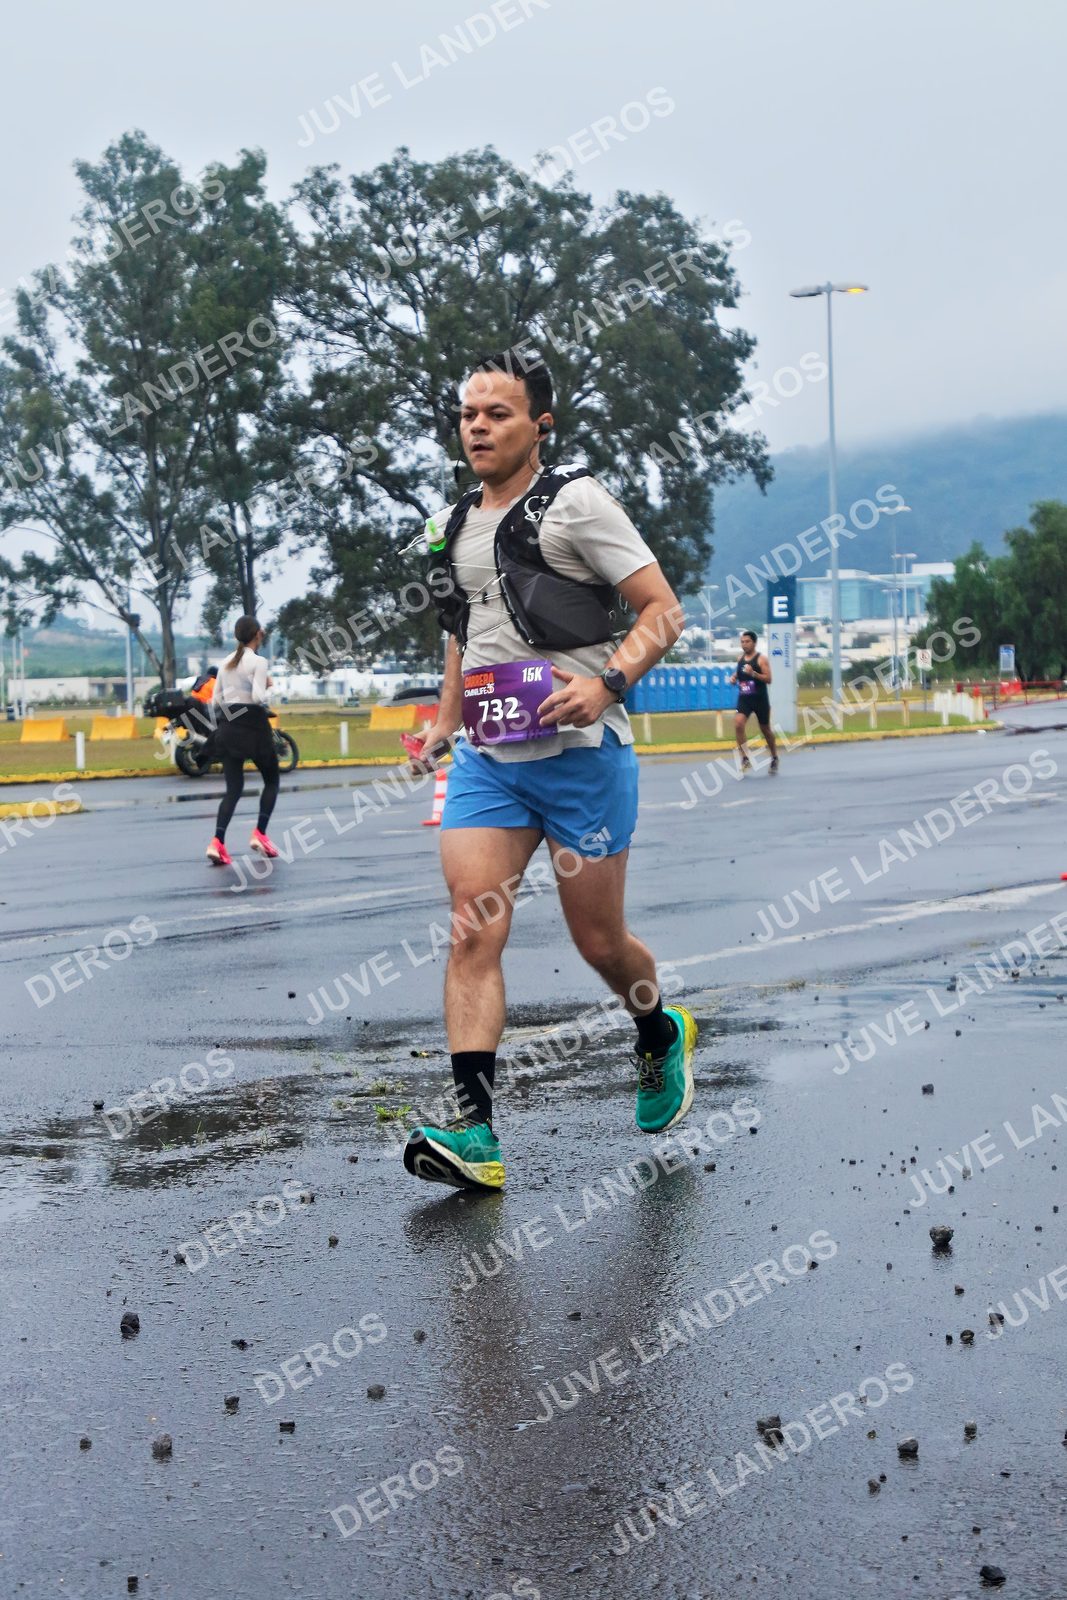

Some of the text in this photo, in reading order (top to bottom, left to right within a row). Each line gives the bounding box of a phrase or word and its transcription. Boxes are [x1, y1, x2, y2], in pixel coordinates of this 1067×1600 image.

[772, 595, 789, 617] E
[522, 666, 544, 682] 15K
[478, 696, 520, 723] 732
